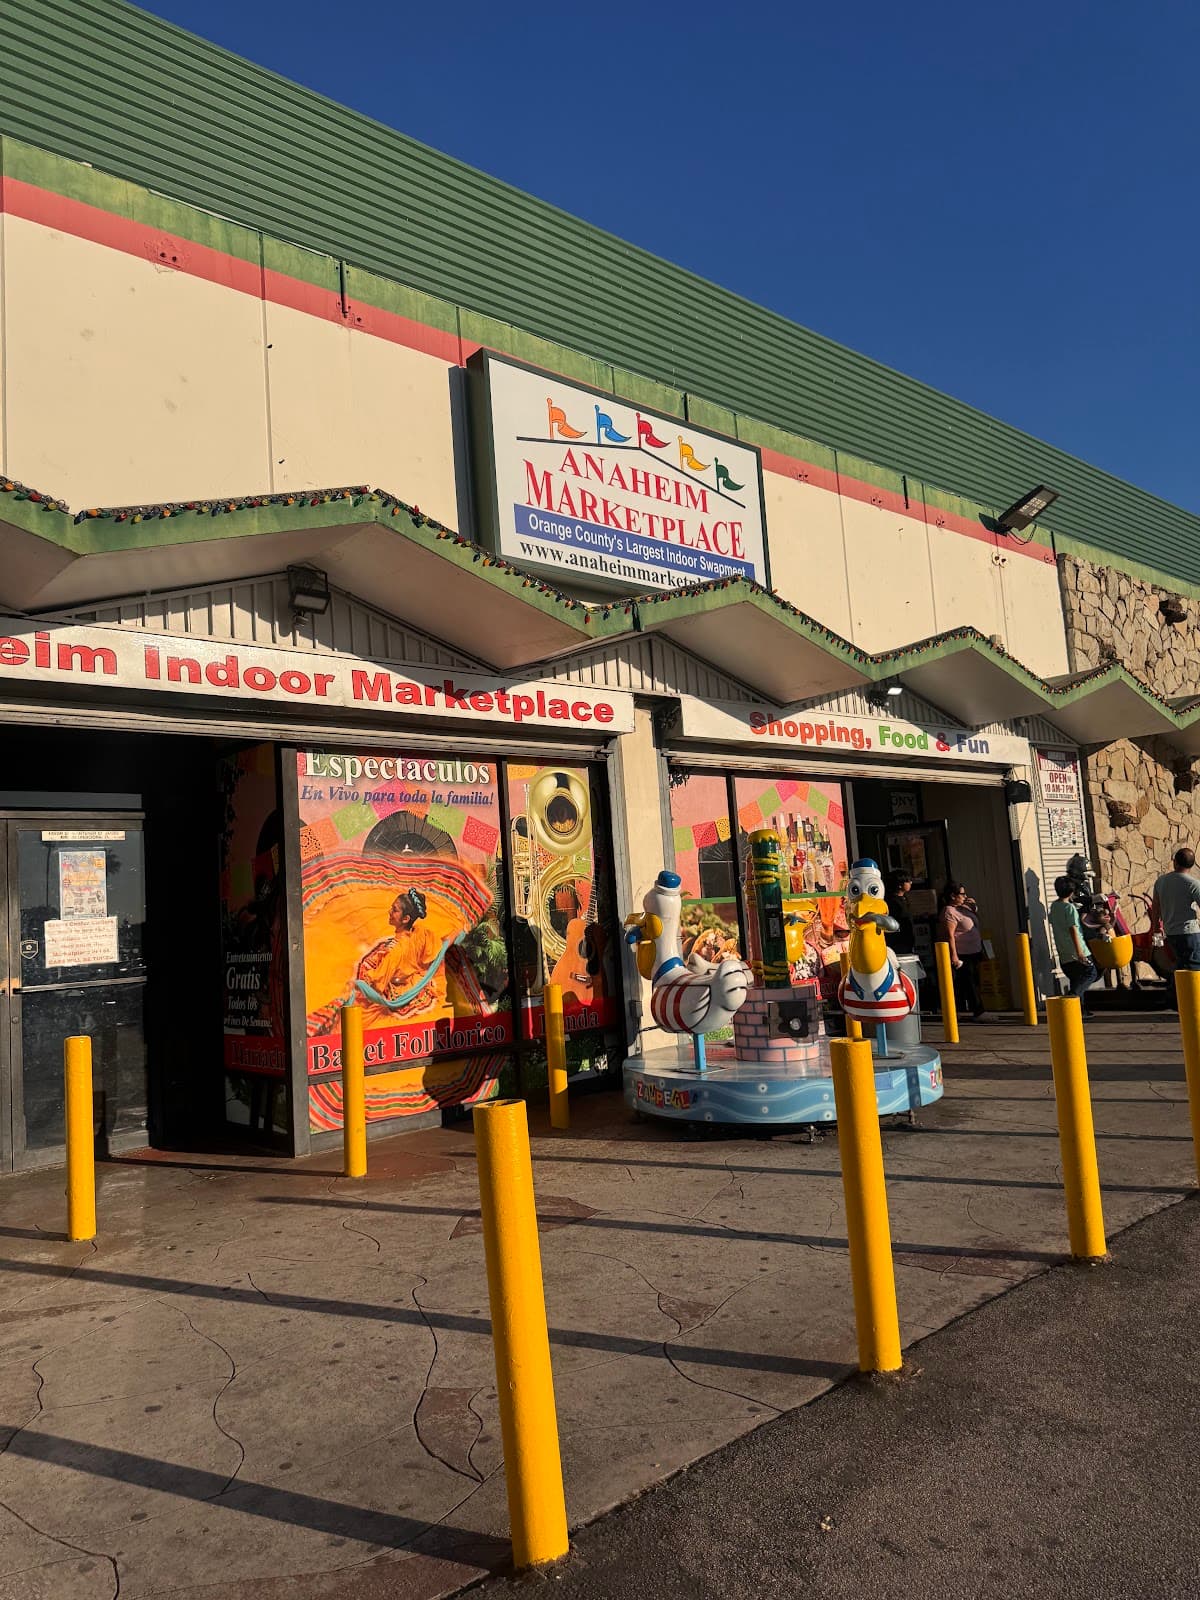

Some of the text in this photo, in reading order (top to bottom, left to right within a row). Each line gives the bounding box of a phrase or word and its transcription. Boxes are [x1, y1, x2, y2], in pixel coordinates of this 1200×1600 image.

[559, 448, 710, 514] ANAHEIM
[522, 458, 746, 560] MARKETPLACE
[528, 513, 572, 541] Orange
[575, 524, 623, 552] County's
[626, 539, 665, 567] Largest
[666, 547, 698, 569] Indoor
[0, 631, 615, 723] eim Indoor Marketplace
[749, 711, 990, 755] Shopping, Food & Fun
[304, 748, 490, 786] Espectaculos
[1049, 772, 1067, 783] OPEN
[300, 785, 494, 808] En Vivo para toda la familia!
[226, 966, 261, 990] Gratis
[229, 996, 246, 1010] Todos
[539, 1007, 600, 1036] nda
[310, 1021, 506, 1072] Baet Folklorico
